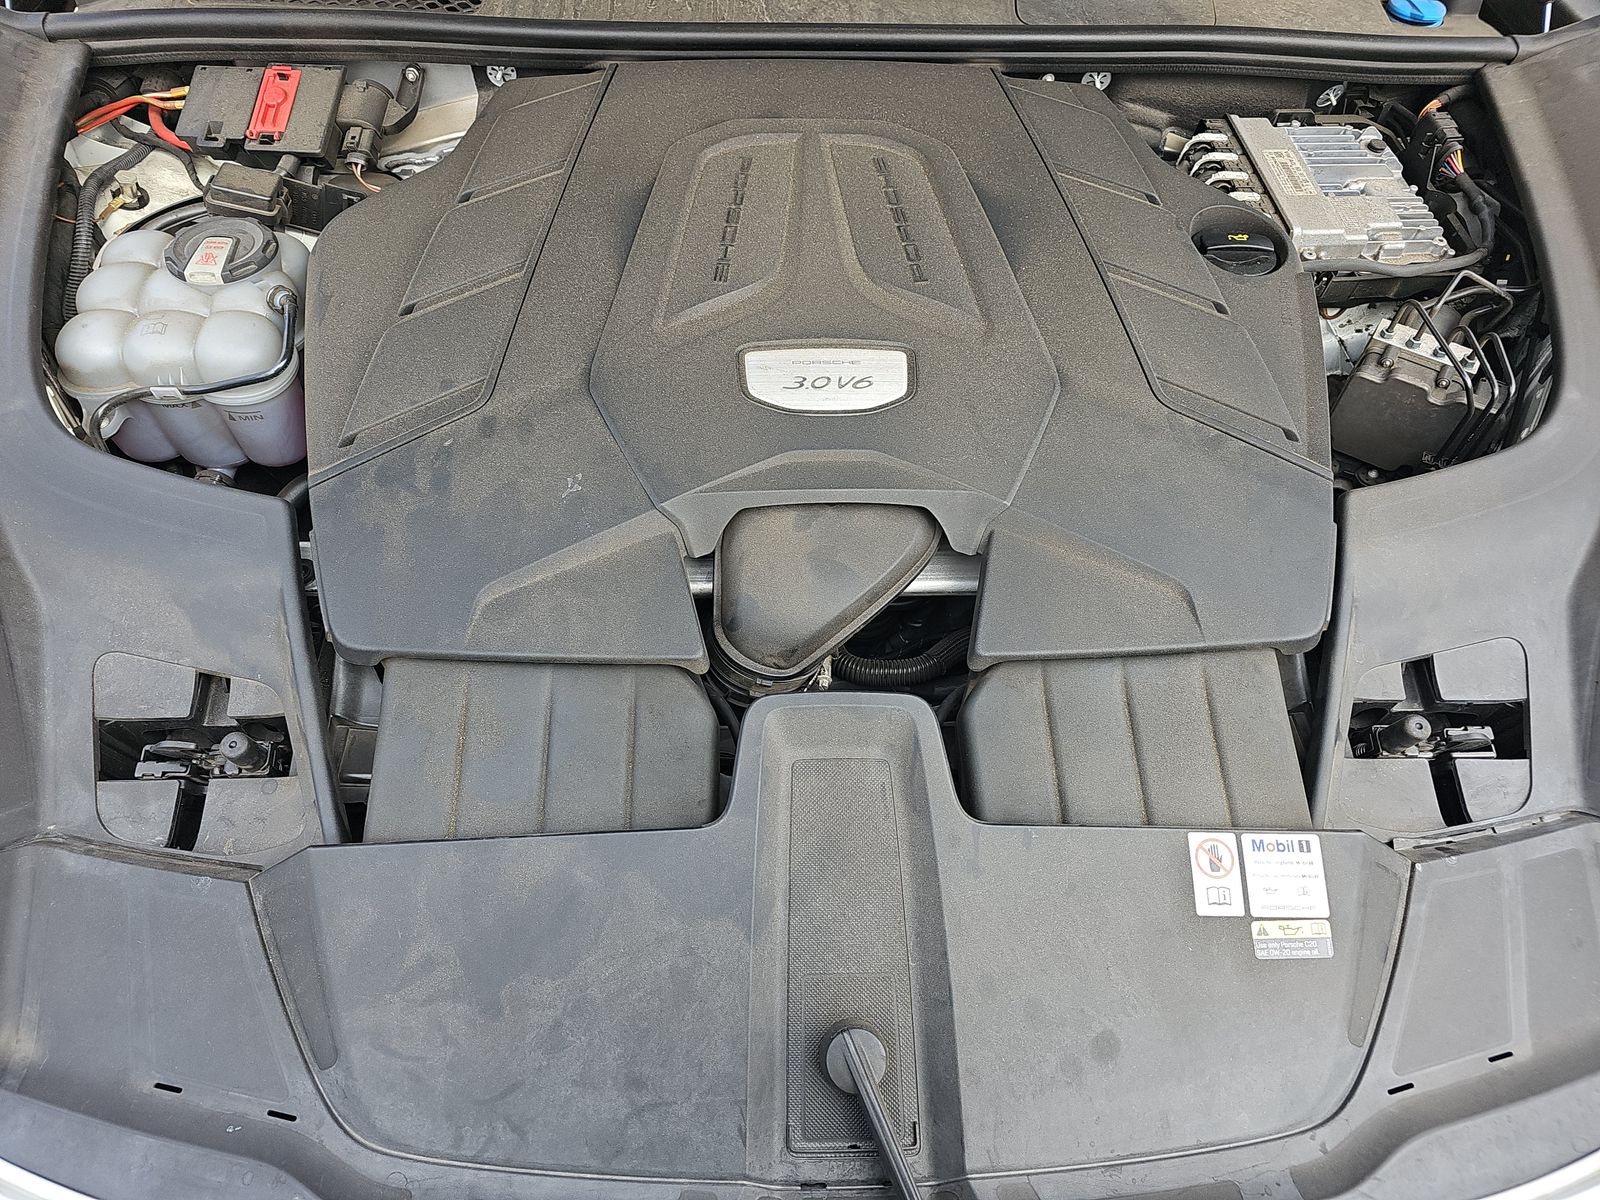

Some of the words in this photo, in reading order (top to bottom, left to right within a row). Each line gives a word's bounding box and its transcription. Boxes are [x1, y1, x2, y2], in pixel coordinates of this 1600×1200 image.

[713, 157, 753, 284] PORSCHE
[872, 156, 929, 283] PORSCHE
[782, 375, 832, 389] 3.0
[838, 375, 874, 389] V6
[1251, 839, 1295, 853] Mobil
[1255, 941, 1268, 949] Use
[1280, 941, 1304, 949] Porsche
[1304, 940, 1317, 948] C20
